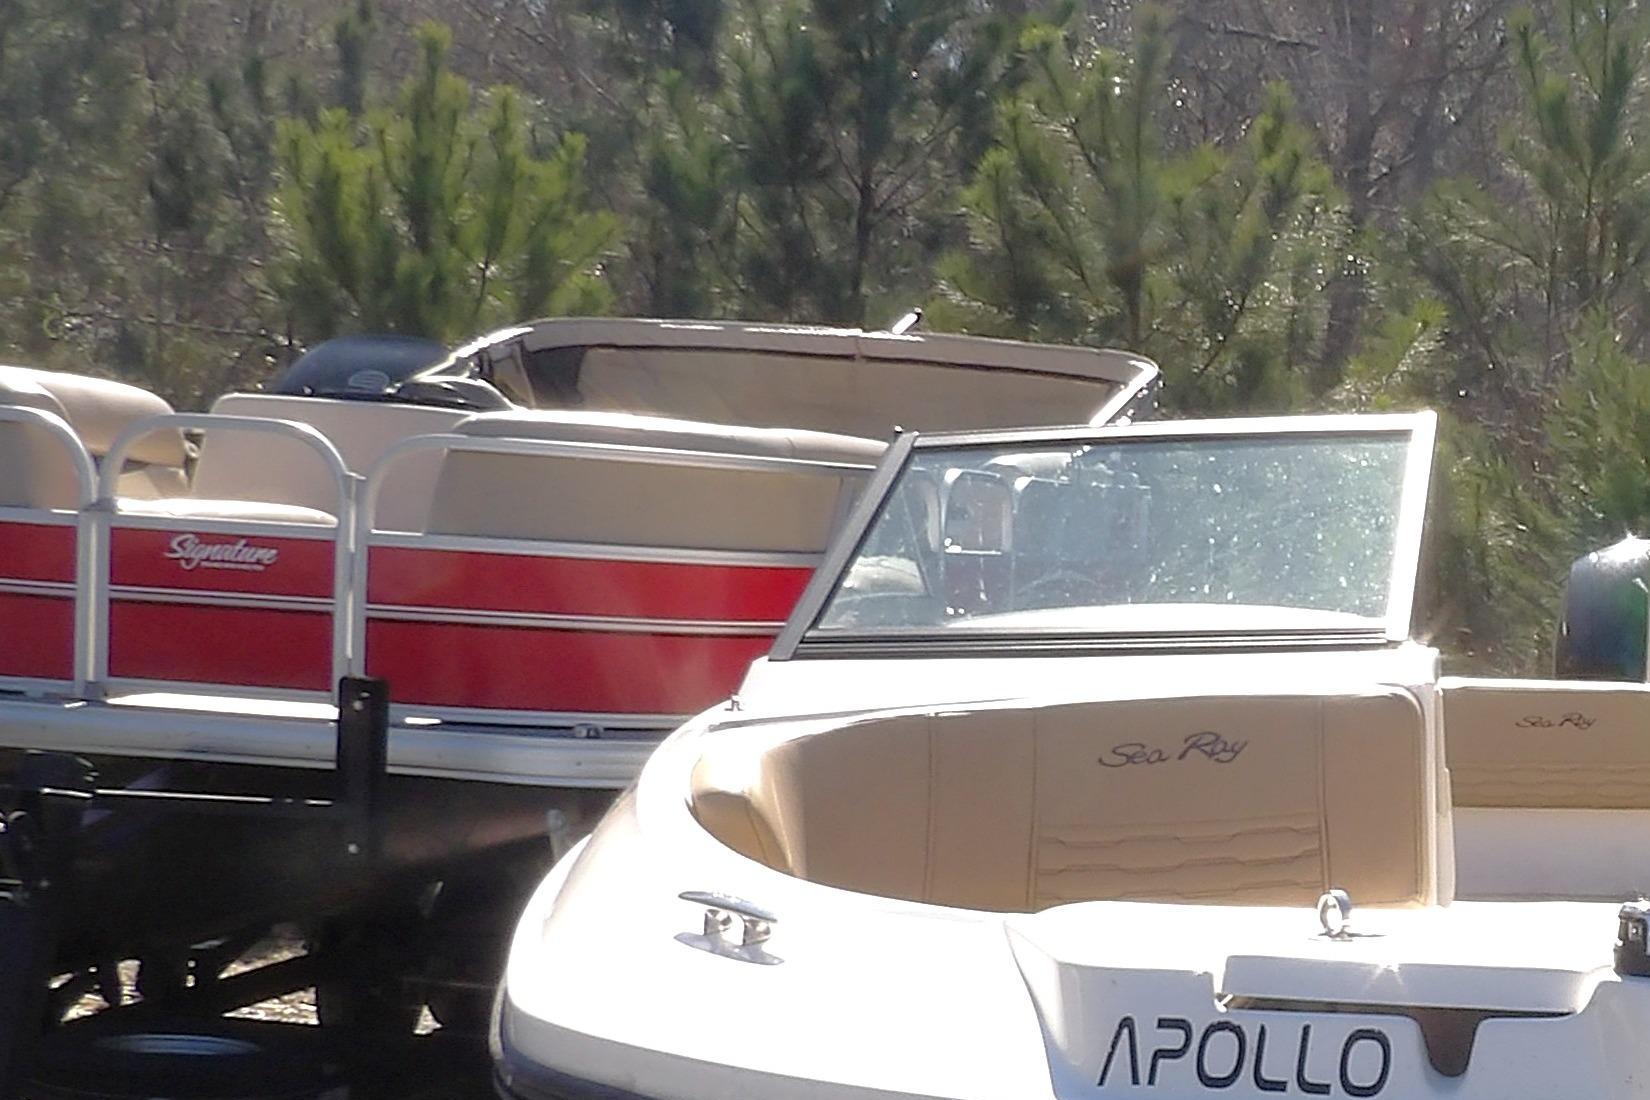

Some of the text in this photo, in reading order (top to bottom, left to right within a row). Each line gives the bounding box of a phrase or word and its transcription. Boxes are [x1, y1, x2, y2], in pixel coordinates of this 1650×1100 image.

[163, 533, 278, 570] Signature
[1098, 731, 1248, 768] Sea Ray
[1097, 1016, 1392, 1098] APOLLO
